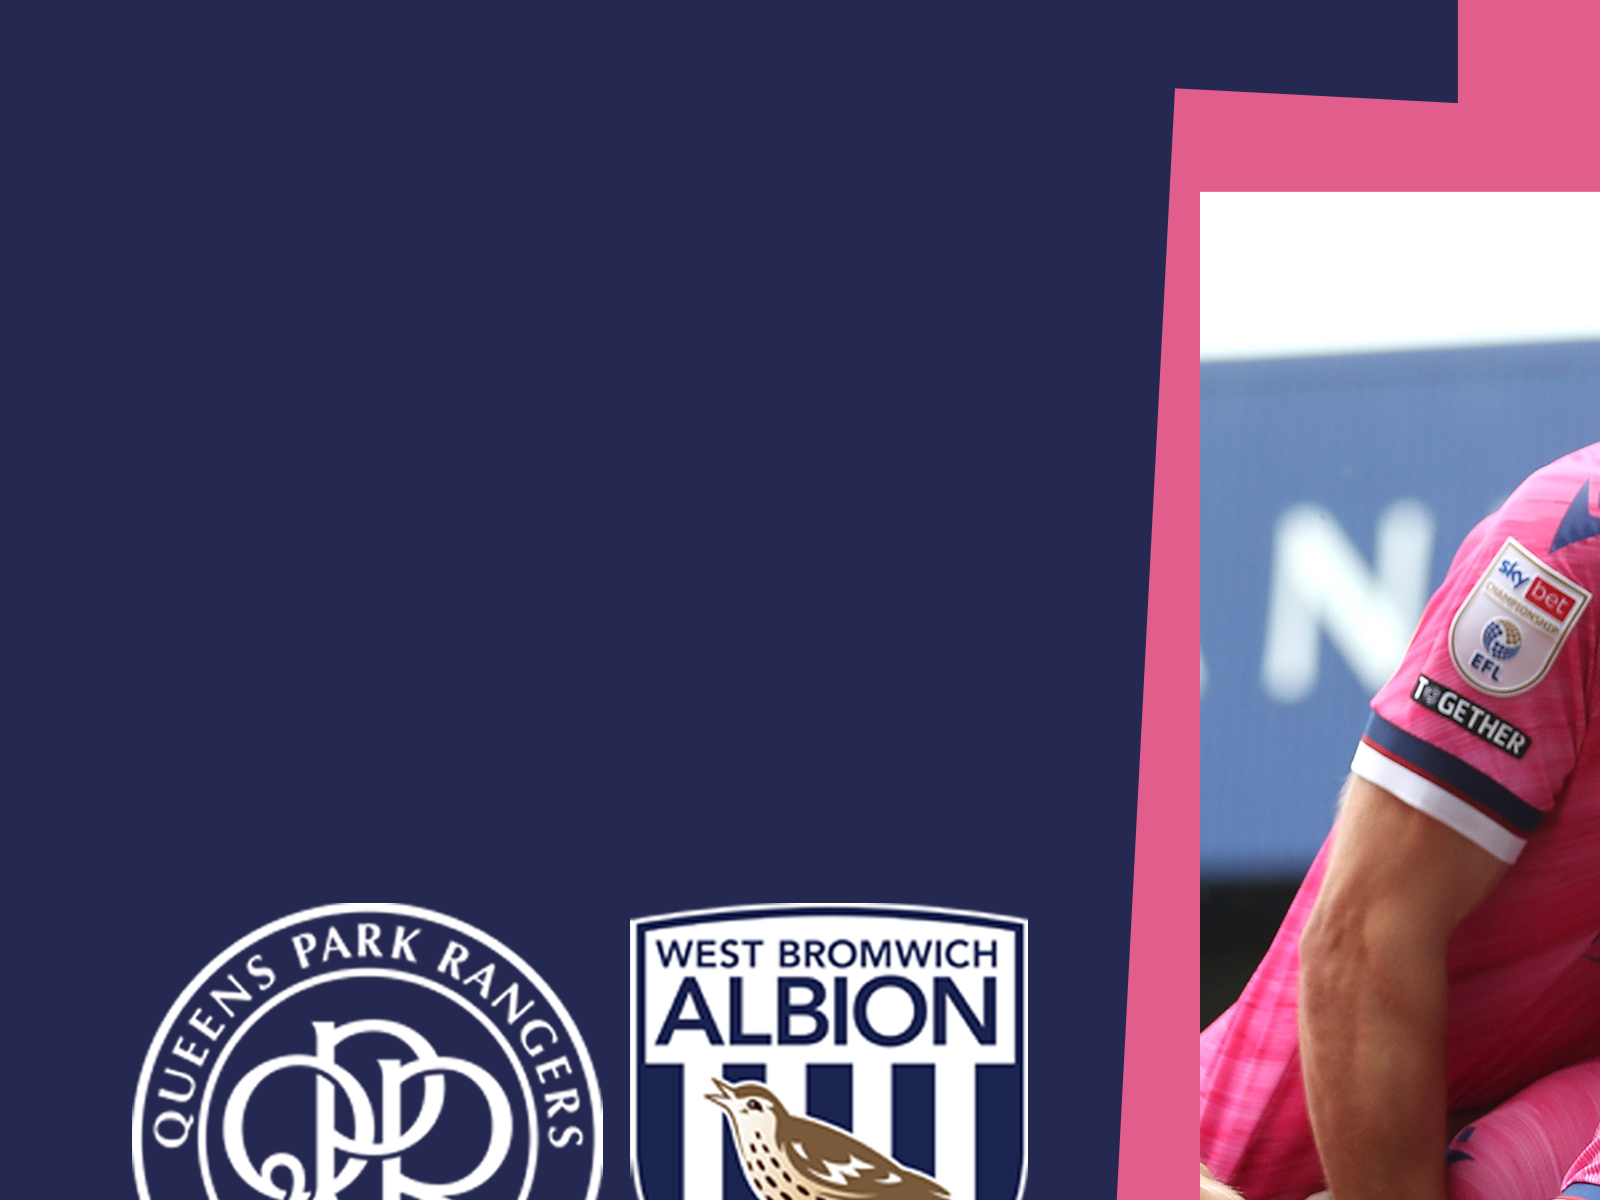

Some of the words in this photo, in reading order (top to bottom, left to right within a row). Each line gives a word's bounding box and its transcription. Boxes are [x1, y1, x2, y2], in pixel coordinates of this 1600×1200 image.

[1499, 560, 1530, 589] sky
[1531, 581, 1569, 616] bet
[1471, 653, 1501, 682] EFL
